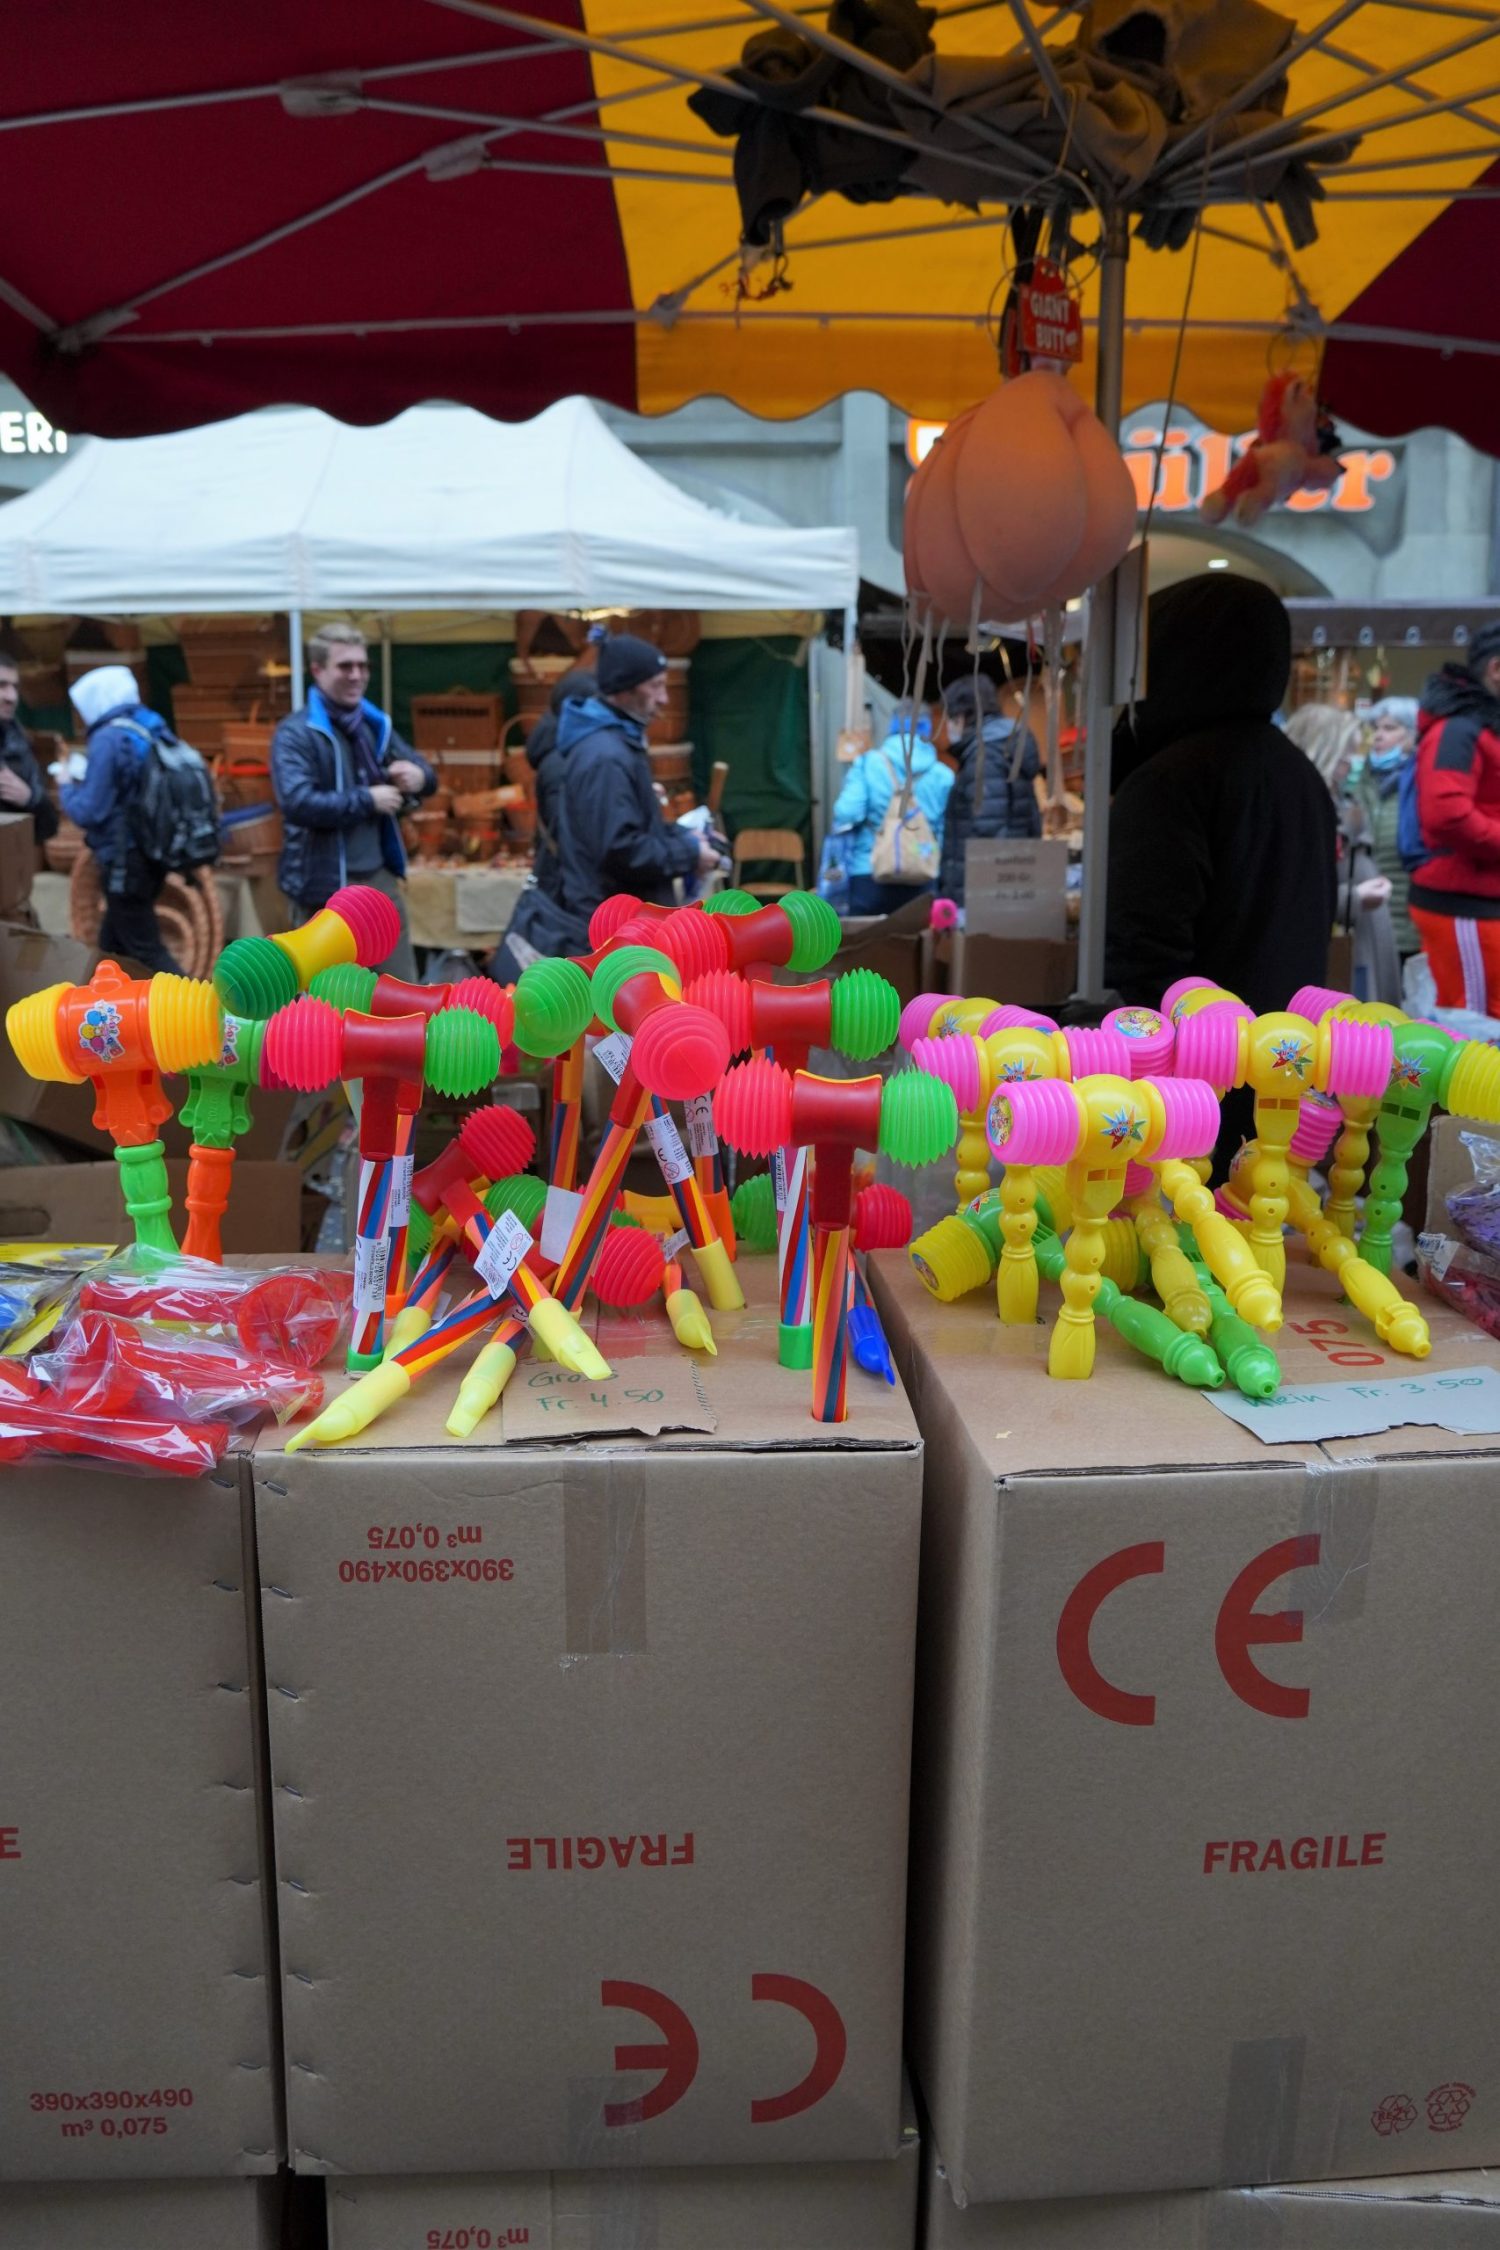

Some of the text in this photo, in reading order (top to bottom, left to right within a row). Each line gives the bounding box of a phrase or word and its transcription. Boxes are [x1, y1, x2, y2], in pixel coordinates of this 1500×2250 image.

[1030, 290, 1069, 325] GIANT
[1036, 322, 1066, 353] BUTT
[528, 1370, 619, 1388] Gros
[1346, 1386, 1390, 1399] Fr.
[1400, 1376, 1485, 1395] 3.50
[536, 1395, 579, 1411] Fr.
[367, 1524, 440, 1550] 0,075
[338, 1559, 514, 1585] 390x390x490
[1056, 1534, 1320, 1727] CE
[507, 1833, 695, 1870] FRAGILE
[1203, 1832, 1387, 1874] FRAGILE
[601, 1974, 847, 2123] CE
[29, 2087, 193, 2112] 390x390x490
[100, 2116, 168, 2139] 0,075
[426, 2225, 491, 2250] 0,075
